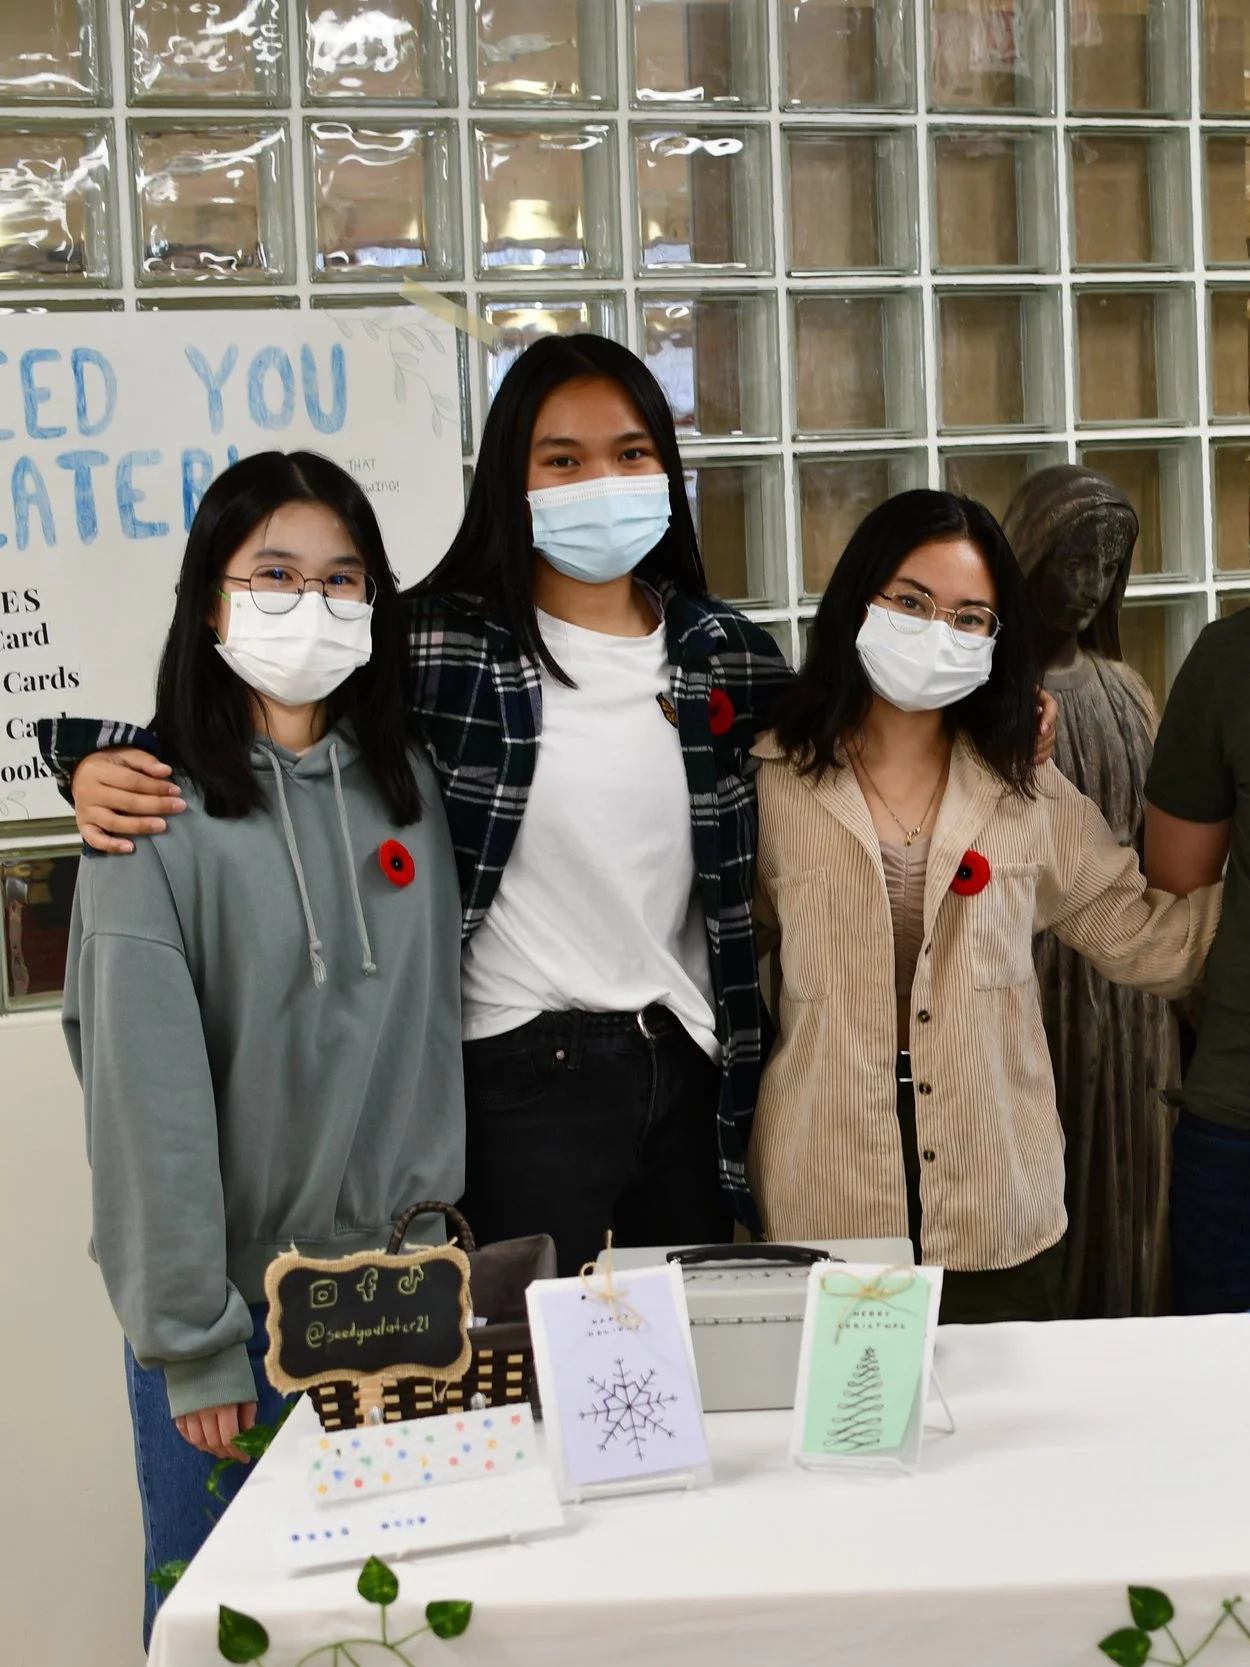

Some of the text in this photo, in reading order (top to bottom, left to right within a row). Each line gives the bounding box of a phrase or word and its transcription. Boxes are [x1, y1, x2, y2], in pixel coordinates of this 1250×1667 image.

[184, 342, 347, 436] YOU
[346, 458, 376, 473] THAT
[361, 479, 399, 494] WING!
[3, 666, 80, 694] Cards
[306, 1314, 429, 1348] @seedyoulater21
